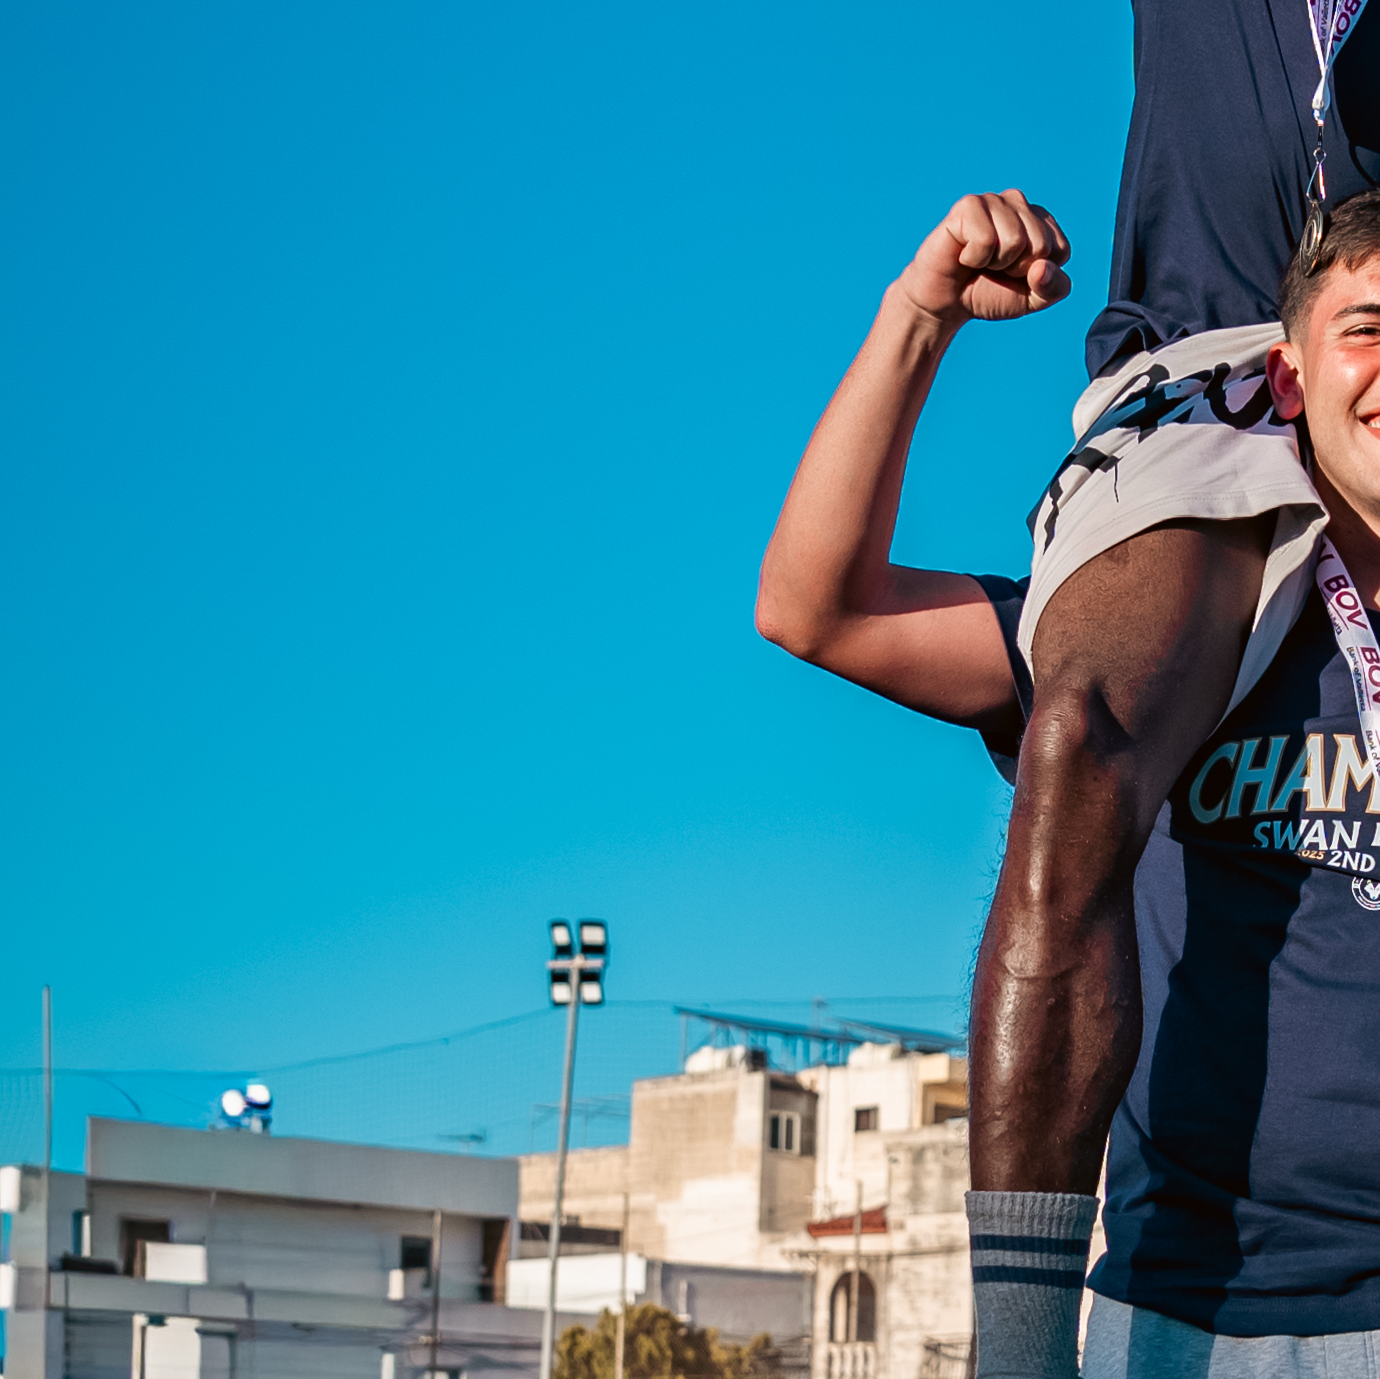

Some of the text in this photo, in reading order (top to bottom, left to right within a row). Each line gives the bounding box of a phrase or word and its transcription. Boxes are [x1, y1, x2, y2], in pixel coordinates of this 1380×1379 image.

[1324, 574, 1368, 630] BOV
[1252, 818, 1362, 851] SWAN
[1327, 850, 1376, 873] 2ND
